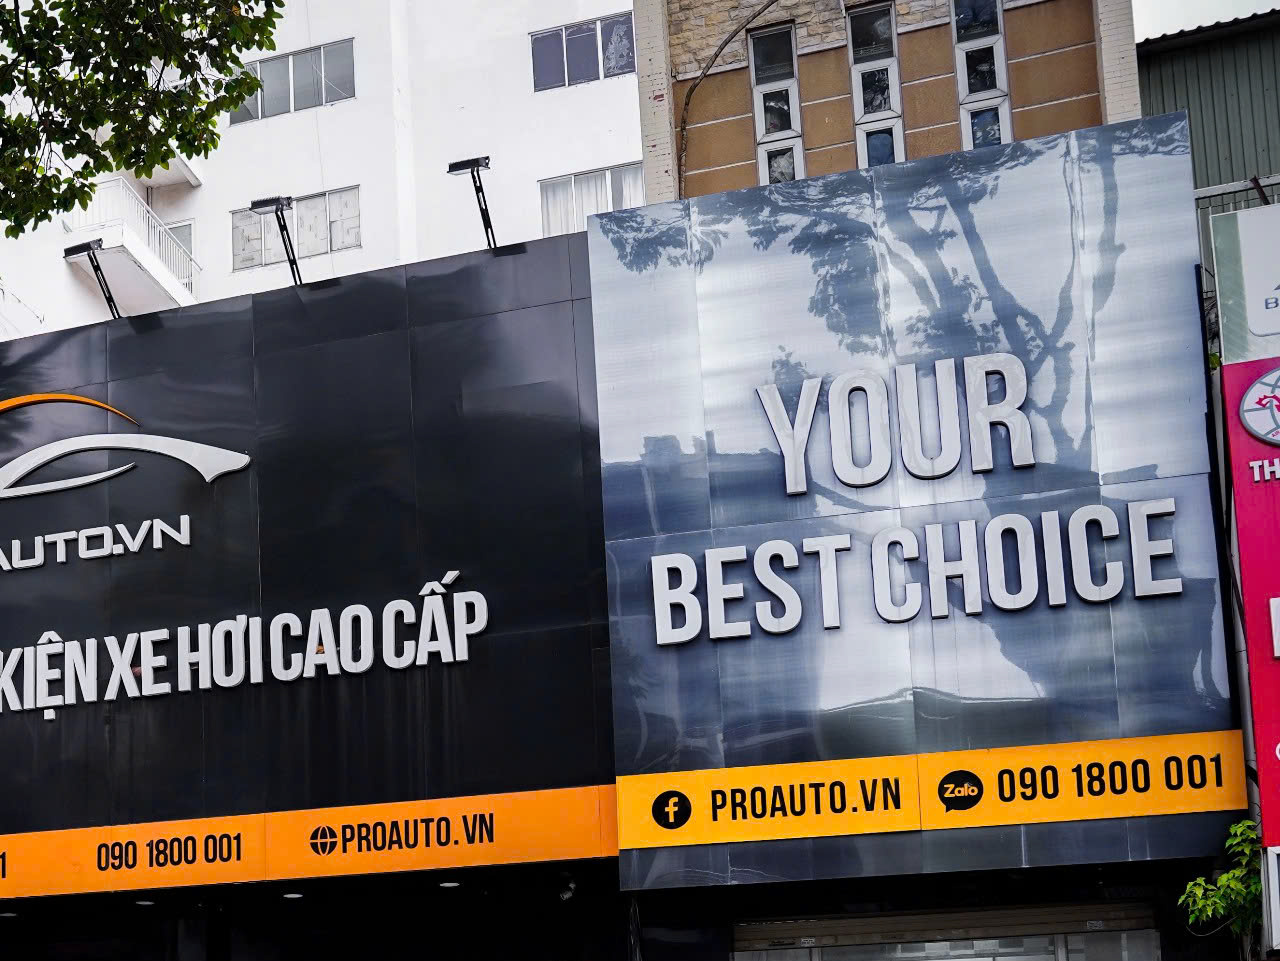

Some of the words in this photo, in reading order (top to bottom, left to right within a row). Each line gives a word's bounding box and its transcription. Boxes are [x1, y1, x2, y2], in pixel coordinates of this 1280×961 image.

[756, 352, 1036, 496] YOUR
[650, 533, 851, 646] BEST
[872, 498, 1183, 624] CHOICE
[104, 628, 172, 701] XE
[178, 614, 264, 692] HƠI
[269, 603, 375, 682] CAO
[382, 570, 489, 670] CẤP
[711, 776, 901, 822] PROAUTO.VN
[943, 781, 979, 798] Zalo
[997, 765, 1059, 803] 090
[1072, 758, 1151, 798] 1800
[1164, 753, 1224, 791] 001
[96, 840, 138, 872] 090
[145, 835, 197, 869] 1800
[204, 832, 242, 864] 001
[341, 812, 494, 854] PROAUTO.VN
